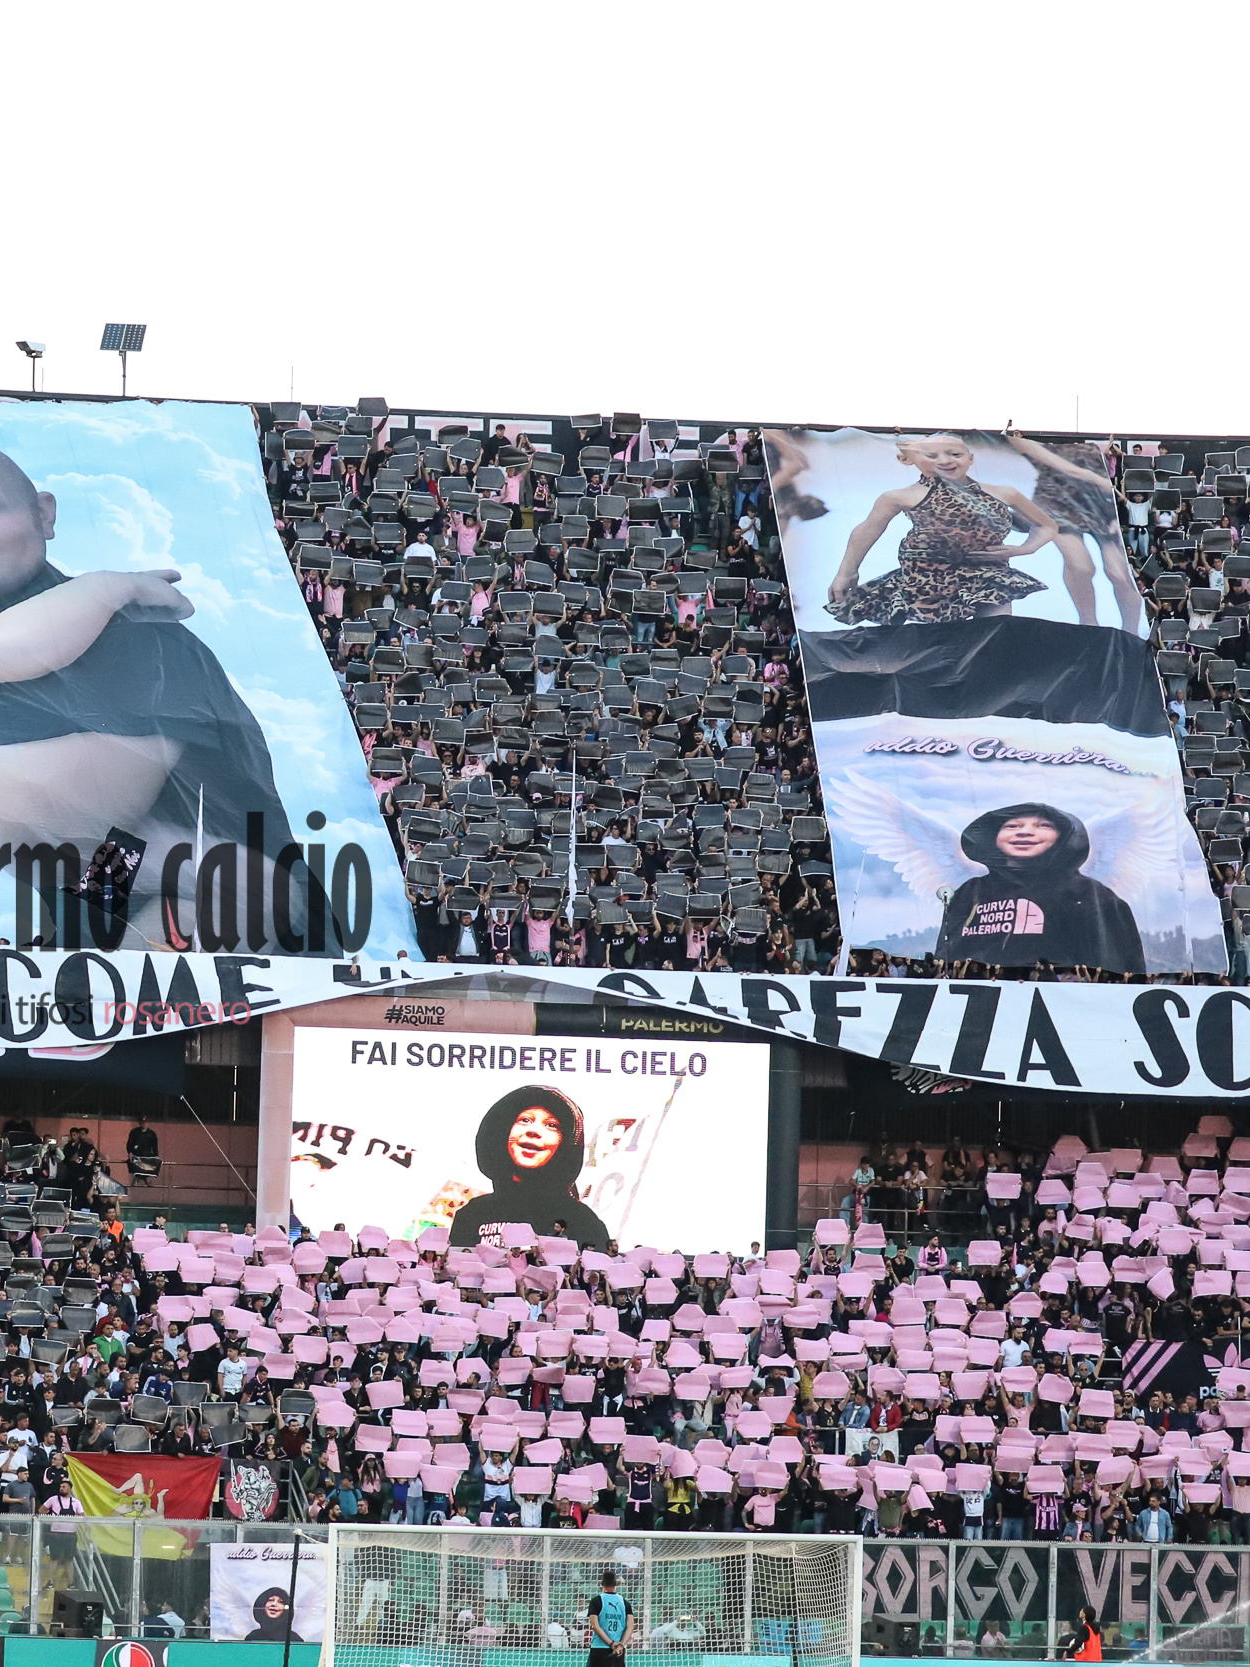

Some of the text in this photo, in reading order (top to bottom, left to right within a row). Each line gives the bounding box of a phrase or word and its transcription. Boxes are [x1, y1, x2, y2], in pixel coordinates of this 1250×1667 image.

[864, 736, 958, 754] addio
[976, 899, 1016, 914] CURVA
[979, 910, 1015, 924] NORD
[961, 922, 1013, 937] PALERMO
[401, 1014, 445, 1026] AQUILE
[621, 1017, 725, 1034] PALERMO
[351, 1040, 707, 1077] FAI SORRIDERE IL CIELO
[478, 1222, 512, 1236] CURV
[480, 1235, 505, 1247] NOR
